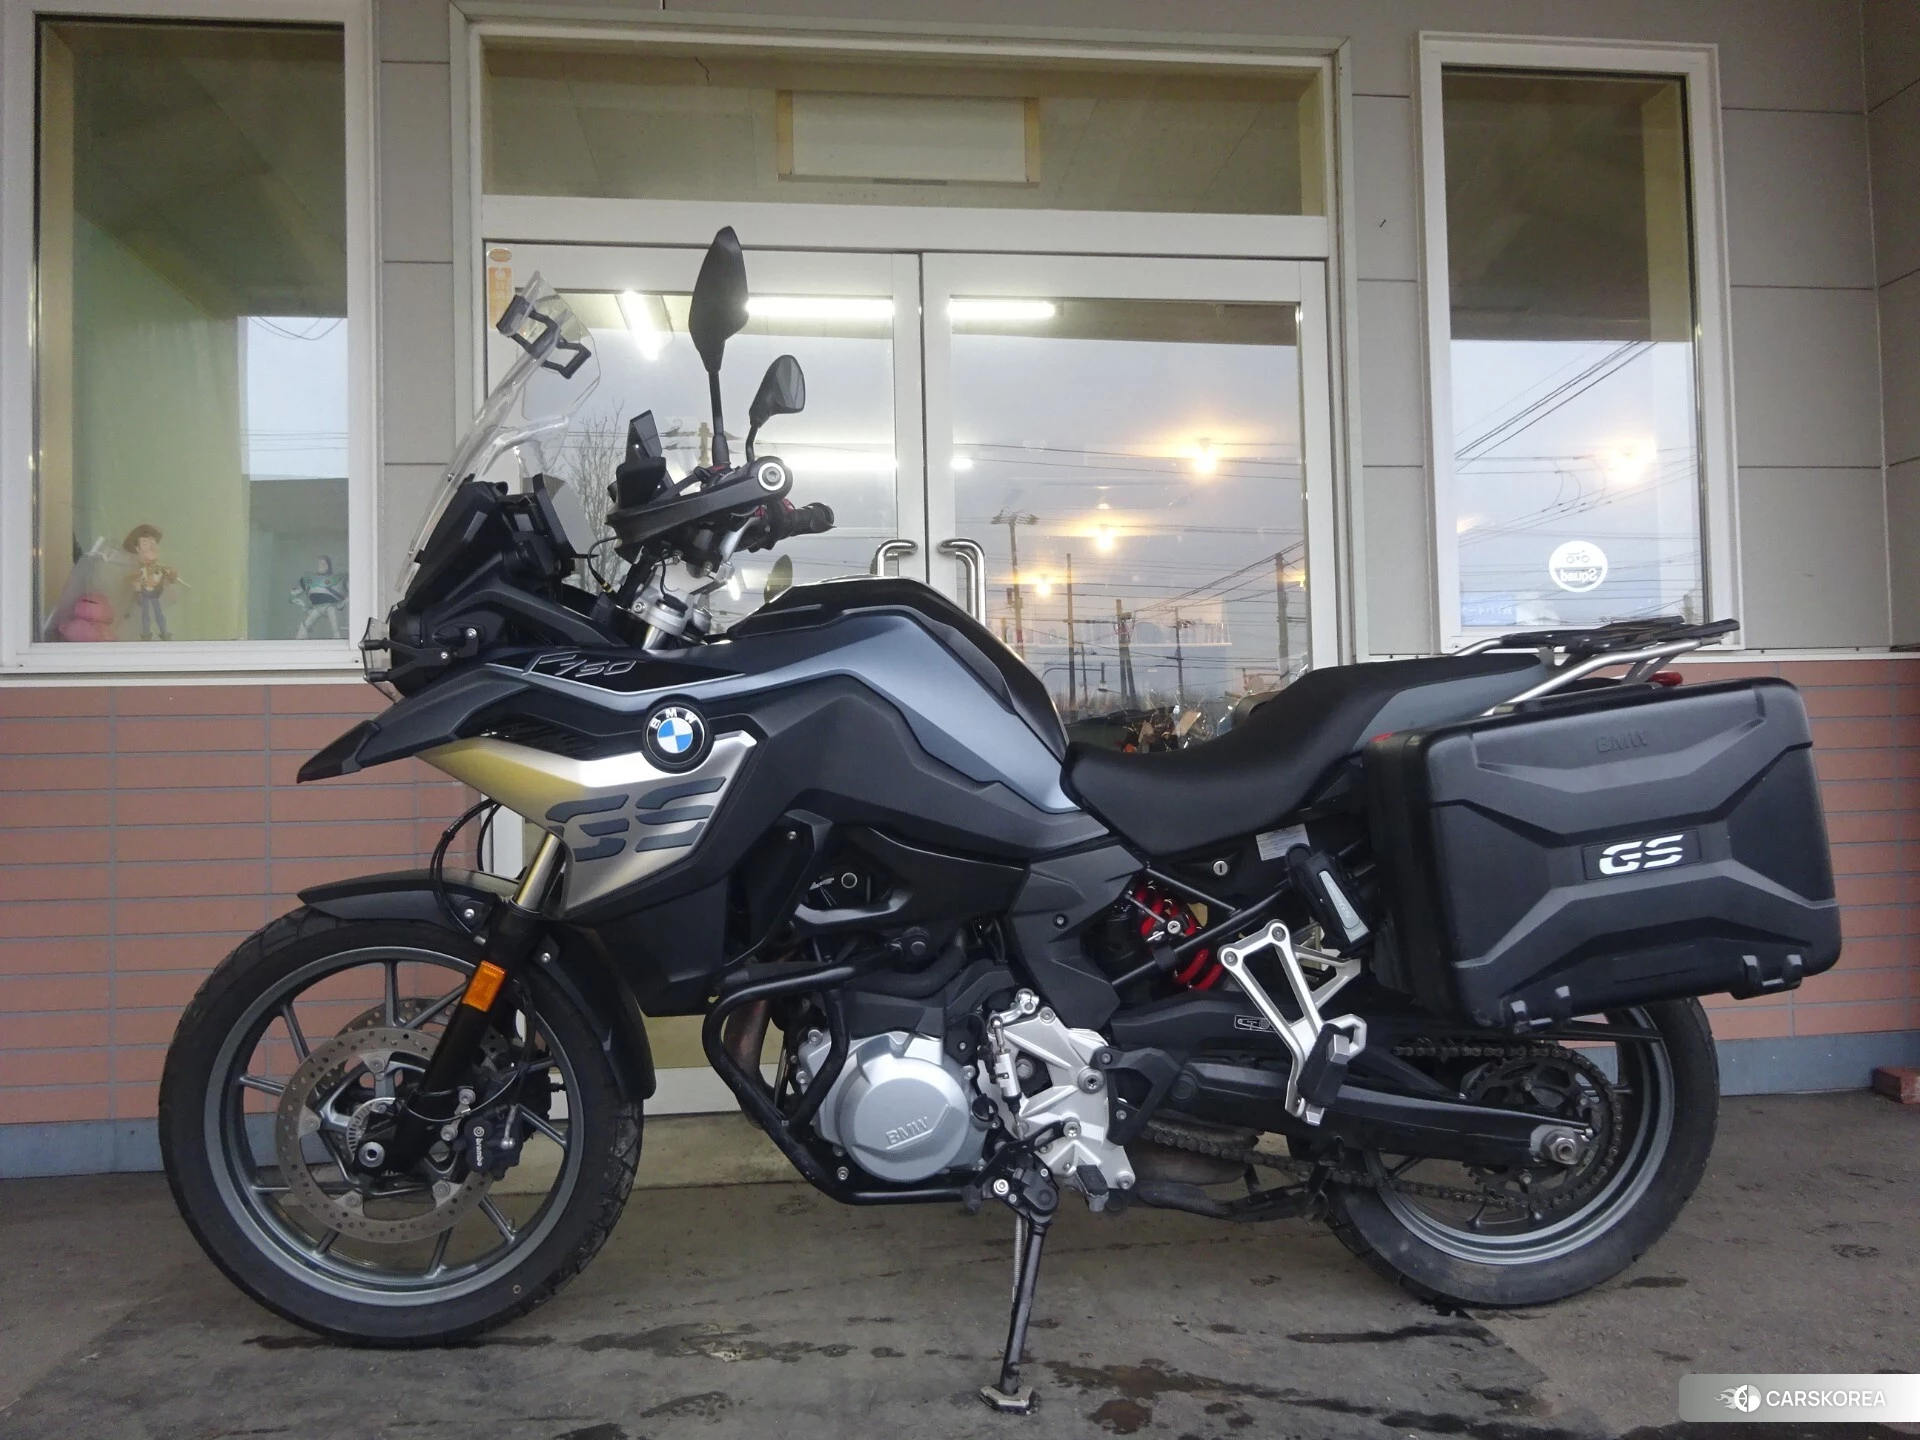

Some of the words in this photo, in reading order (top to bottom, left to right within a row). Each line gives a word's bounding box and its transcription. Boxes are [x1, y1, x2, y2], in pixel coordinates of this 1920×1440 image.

[650, 708, 698, 729] BMW
[1599, 834, 1684, 875] GS
[886, 1116, 927, 1144] BMW
[475, 1138, 483, 1166] brembo
